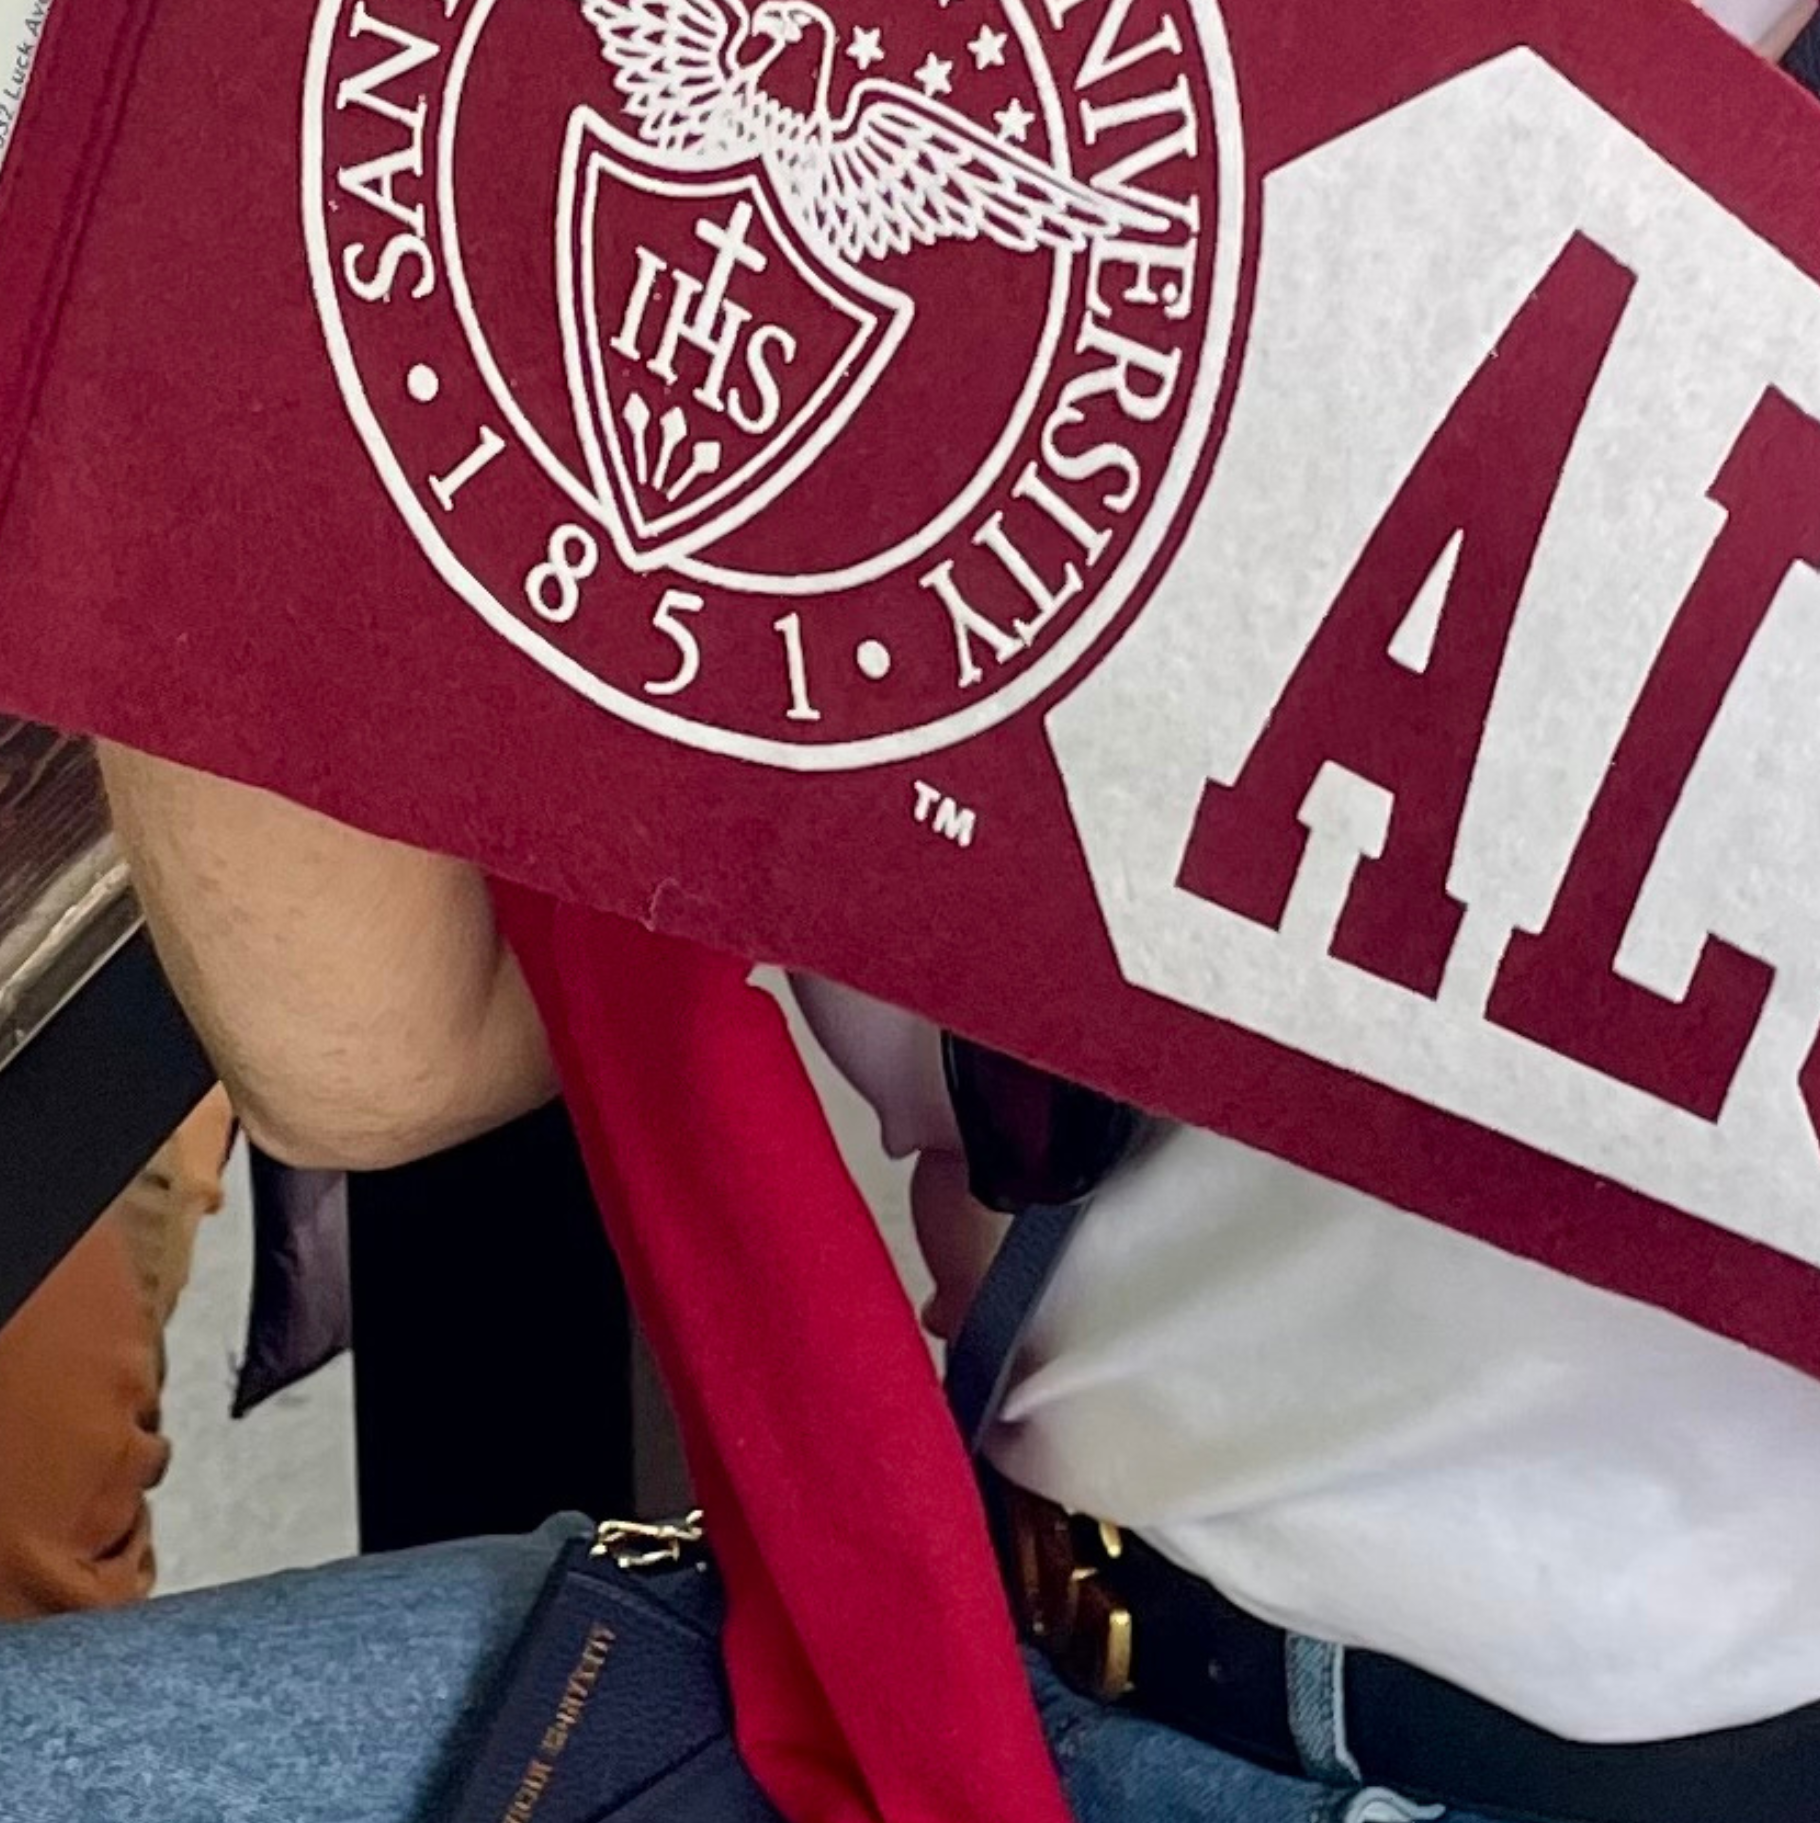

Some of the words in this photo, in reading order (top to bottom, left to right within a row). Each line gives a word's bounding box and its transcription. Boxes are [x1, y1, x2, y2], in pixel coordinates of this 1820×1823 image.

[3, 43, 34, 103] Luck
[610, 243, 797, 434] IHS
[914, 779, 976, 847] TM
